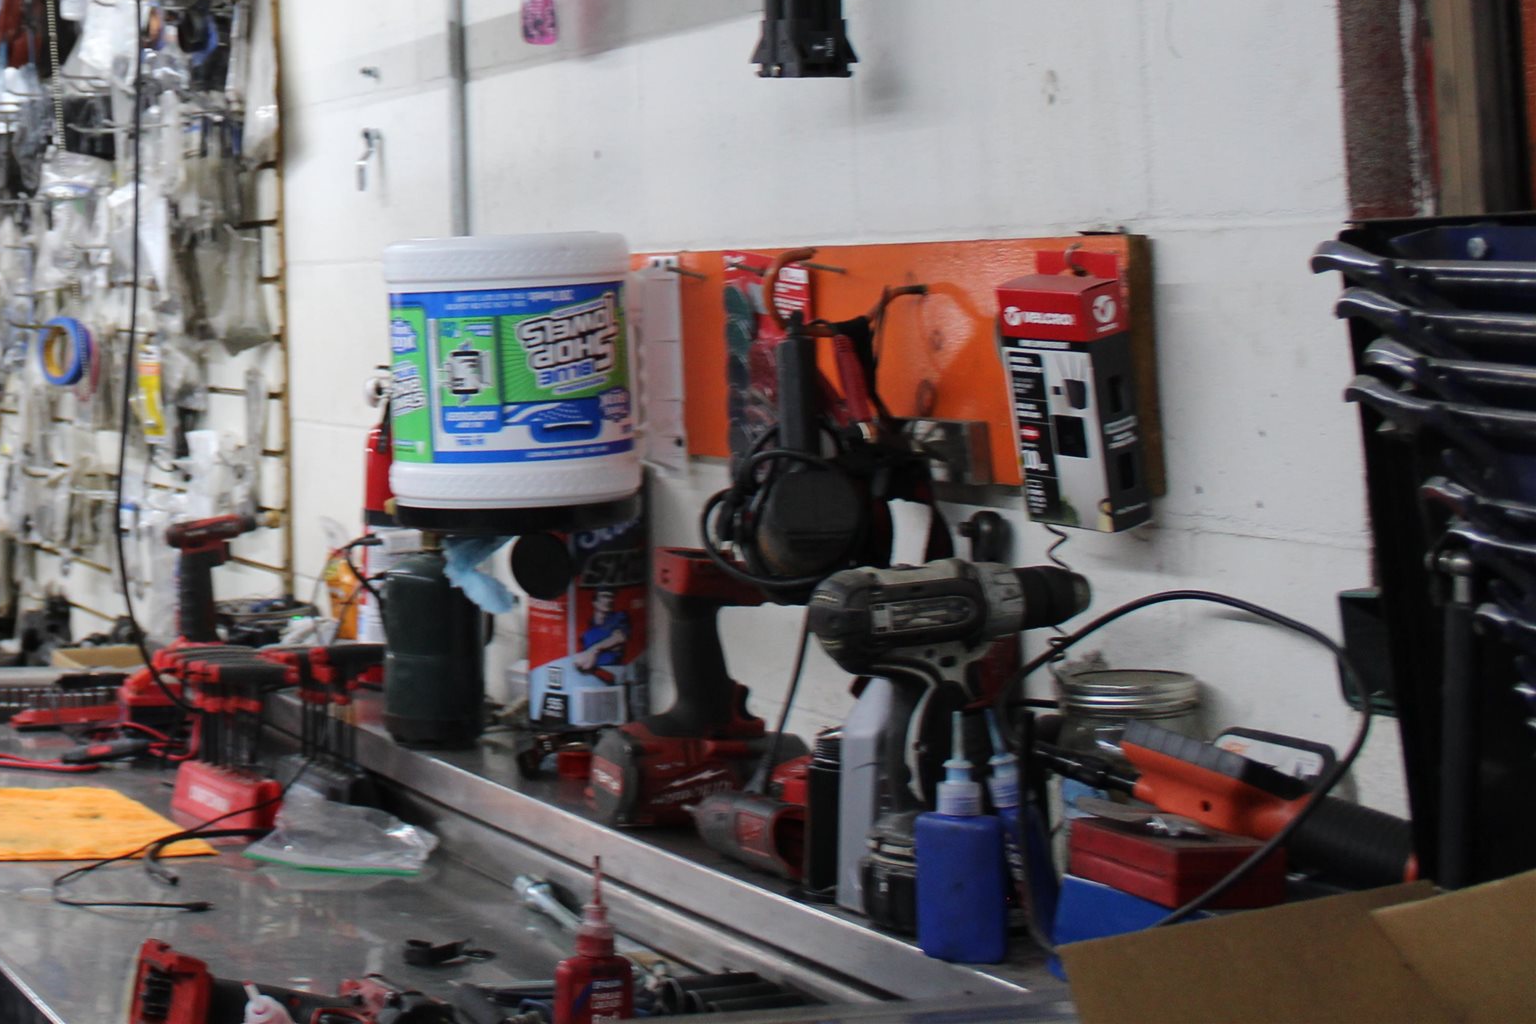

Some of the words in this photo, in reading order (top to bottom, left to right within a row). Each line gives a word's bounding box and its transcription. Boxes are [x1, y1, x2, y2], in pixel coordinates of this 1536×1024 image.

[518, 292, 617, 349] TOWELS
[529, 326, 619, 373] SHOP
[539, 359, 595, 386] BLUE
